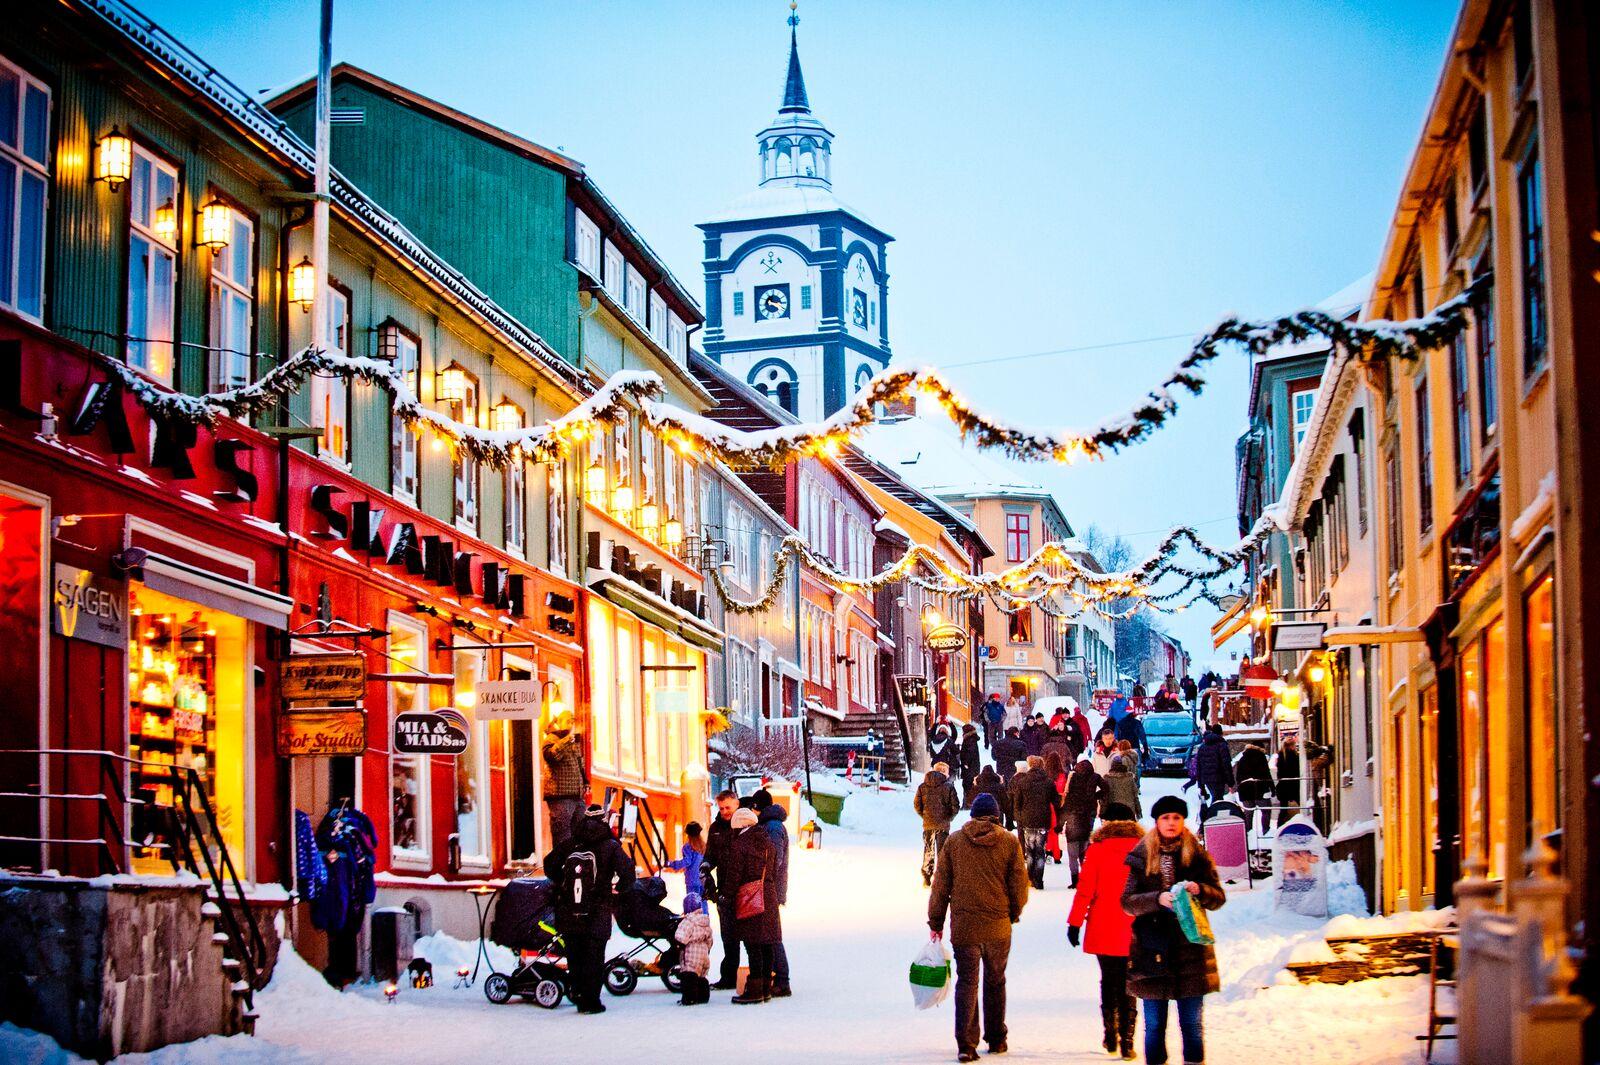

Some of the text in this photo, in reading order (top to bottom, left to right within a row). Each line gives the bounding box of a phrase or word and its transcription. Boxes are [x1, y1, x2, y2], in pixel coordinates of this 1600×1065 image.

[57, 579, 122, 621] SAGEN
[981, 647, 987, 655] P
[480, 691, 537, 704] SKANCKE BUA
[397, 720, 448, 734] MIA &
[313, 732, 362, 748] Studio
